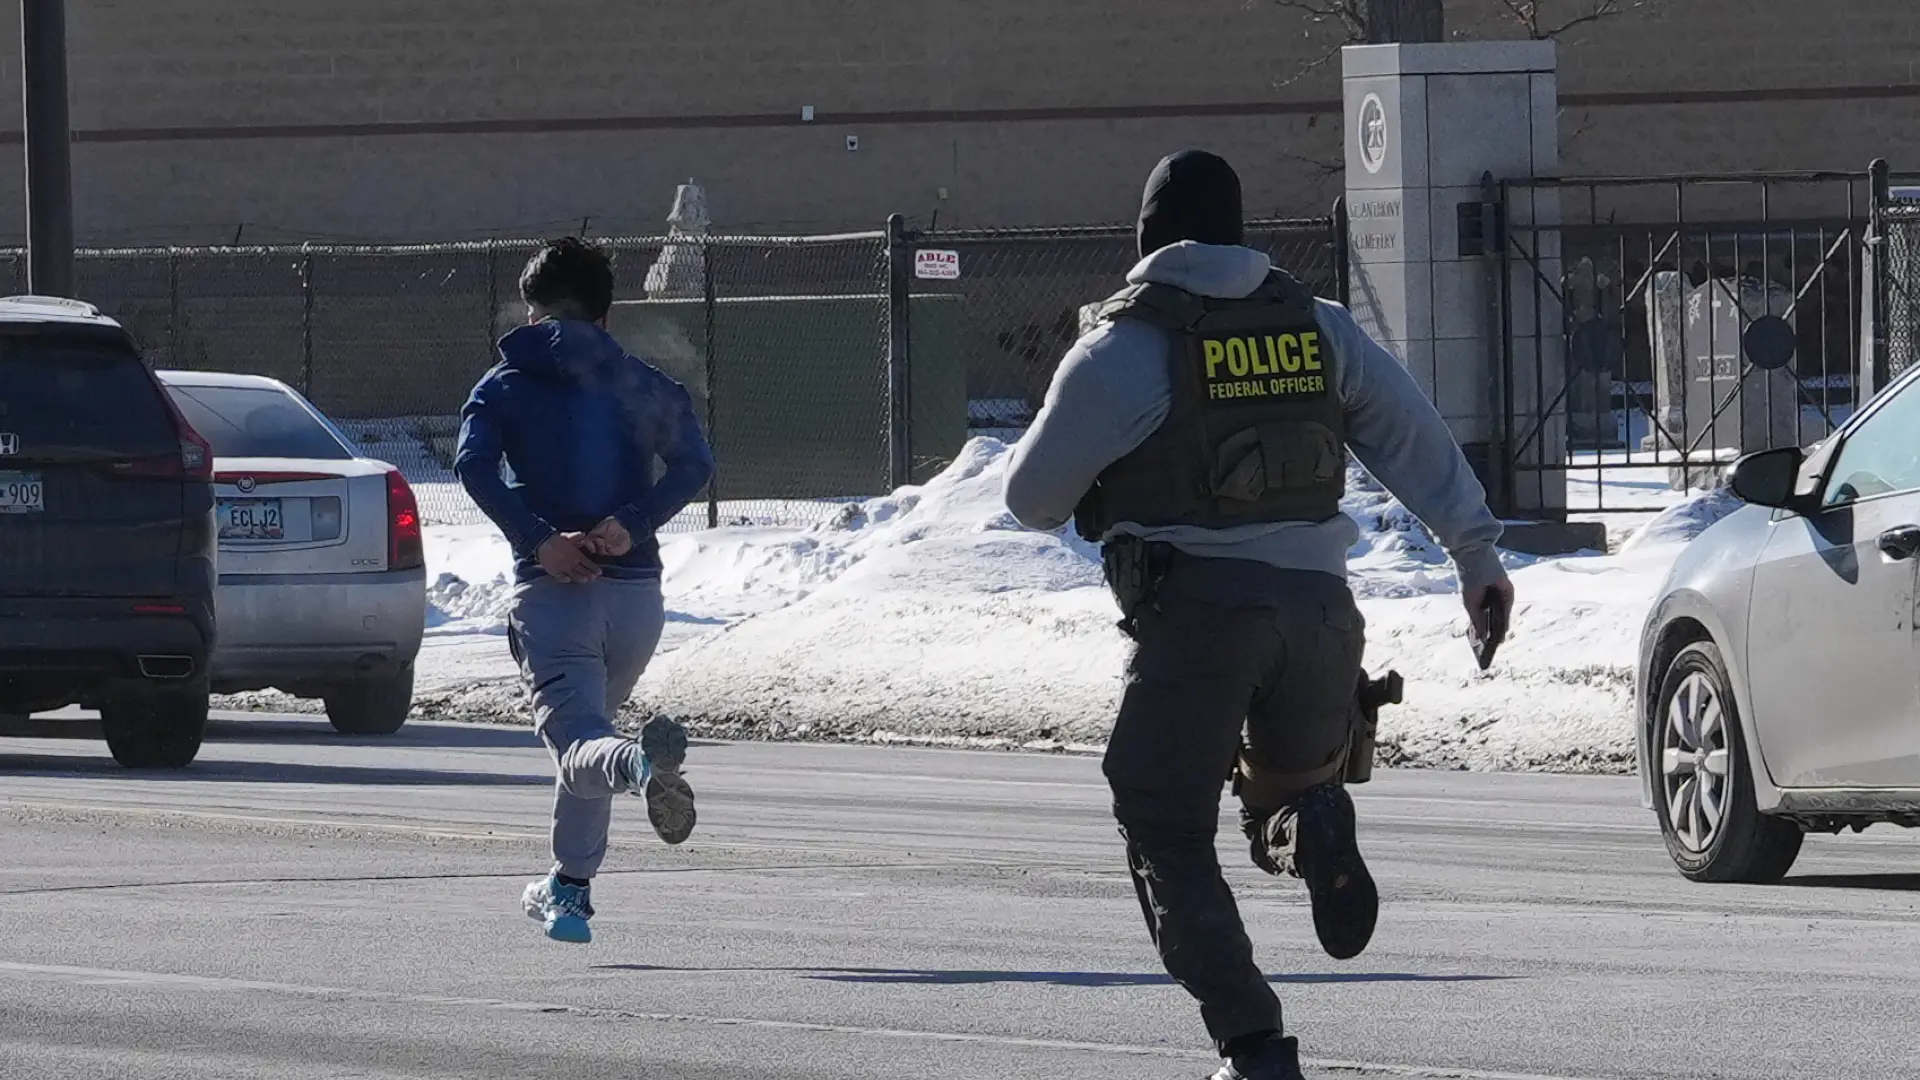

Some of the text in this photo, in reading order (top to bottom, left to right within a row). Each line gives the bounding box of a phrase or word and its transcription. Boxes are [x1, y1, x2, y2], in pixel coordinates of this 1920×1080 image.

[918, 252, 955, 264] ABLE
[1203, 332, 1321, 378] POLICE
[1209, 376, 1324, 399] FEDERAL OFFICER
[9, 483, 39, 504] 909
[231, 508, 278, 527] ECLJ2
